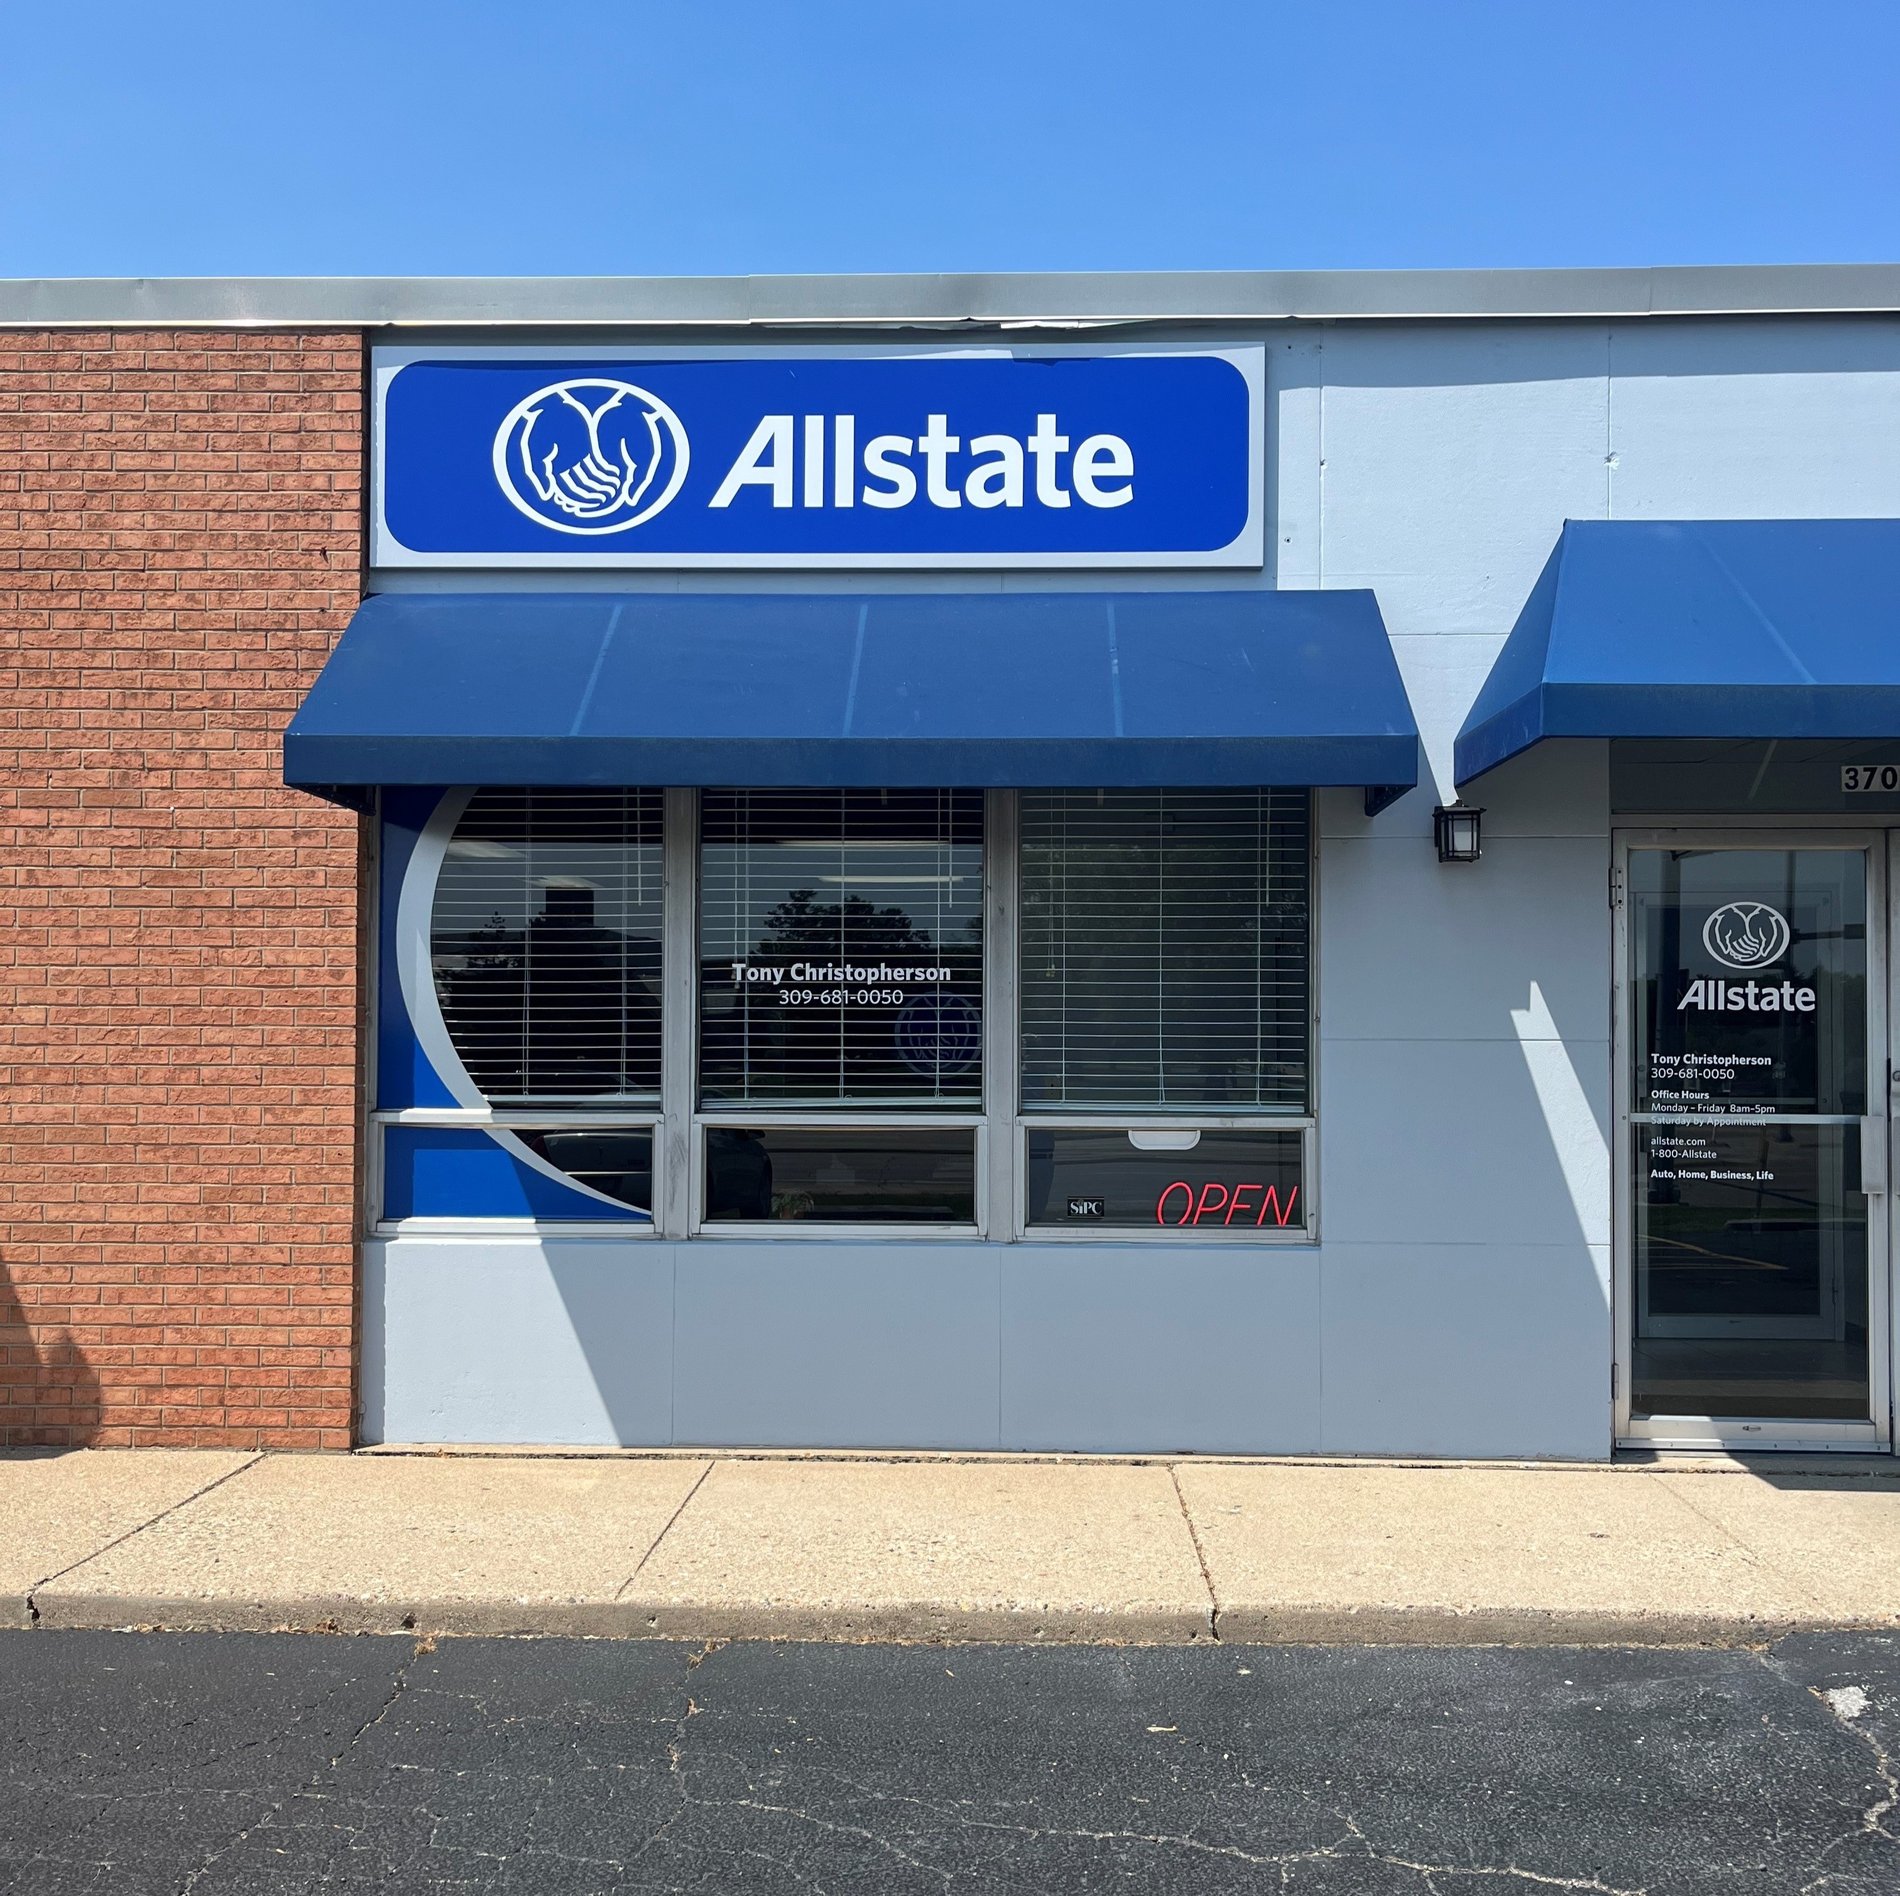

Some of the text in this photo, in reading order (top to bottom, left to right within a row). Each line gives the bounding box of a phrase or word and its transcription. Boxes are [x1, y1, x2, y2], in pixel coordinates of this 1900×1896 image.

[708, 414, 1134, 509] Allstate
[732, 962, 951, 985] Tony Christopherson
[779, 989, 904, 1005] 309-681-0050
[1677, 979, 1816, 1012] Allstate
[1651, 1053, 1771, 1066] Tony Christopherson
[1651, 1068, 1734, 1079] 309-681-0050
[1651, 1090, 1710, 1100] Office Hours
[1651, 1103, 1689, 1114] Monday
[1697, 1104, 1726, 1115] Friday
[1651, 1116, 1767, 1128] Saturday by Appointment
[1651, 1137, 1705, 1146] allstate.com
[1651, 1150, 1717, 1159] 1-800-Allstate
[1651, 1170, 1774, 1181] Auto, Home, Business, Life
[1157, 1181, 1298, 1225] OPEN
